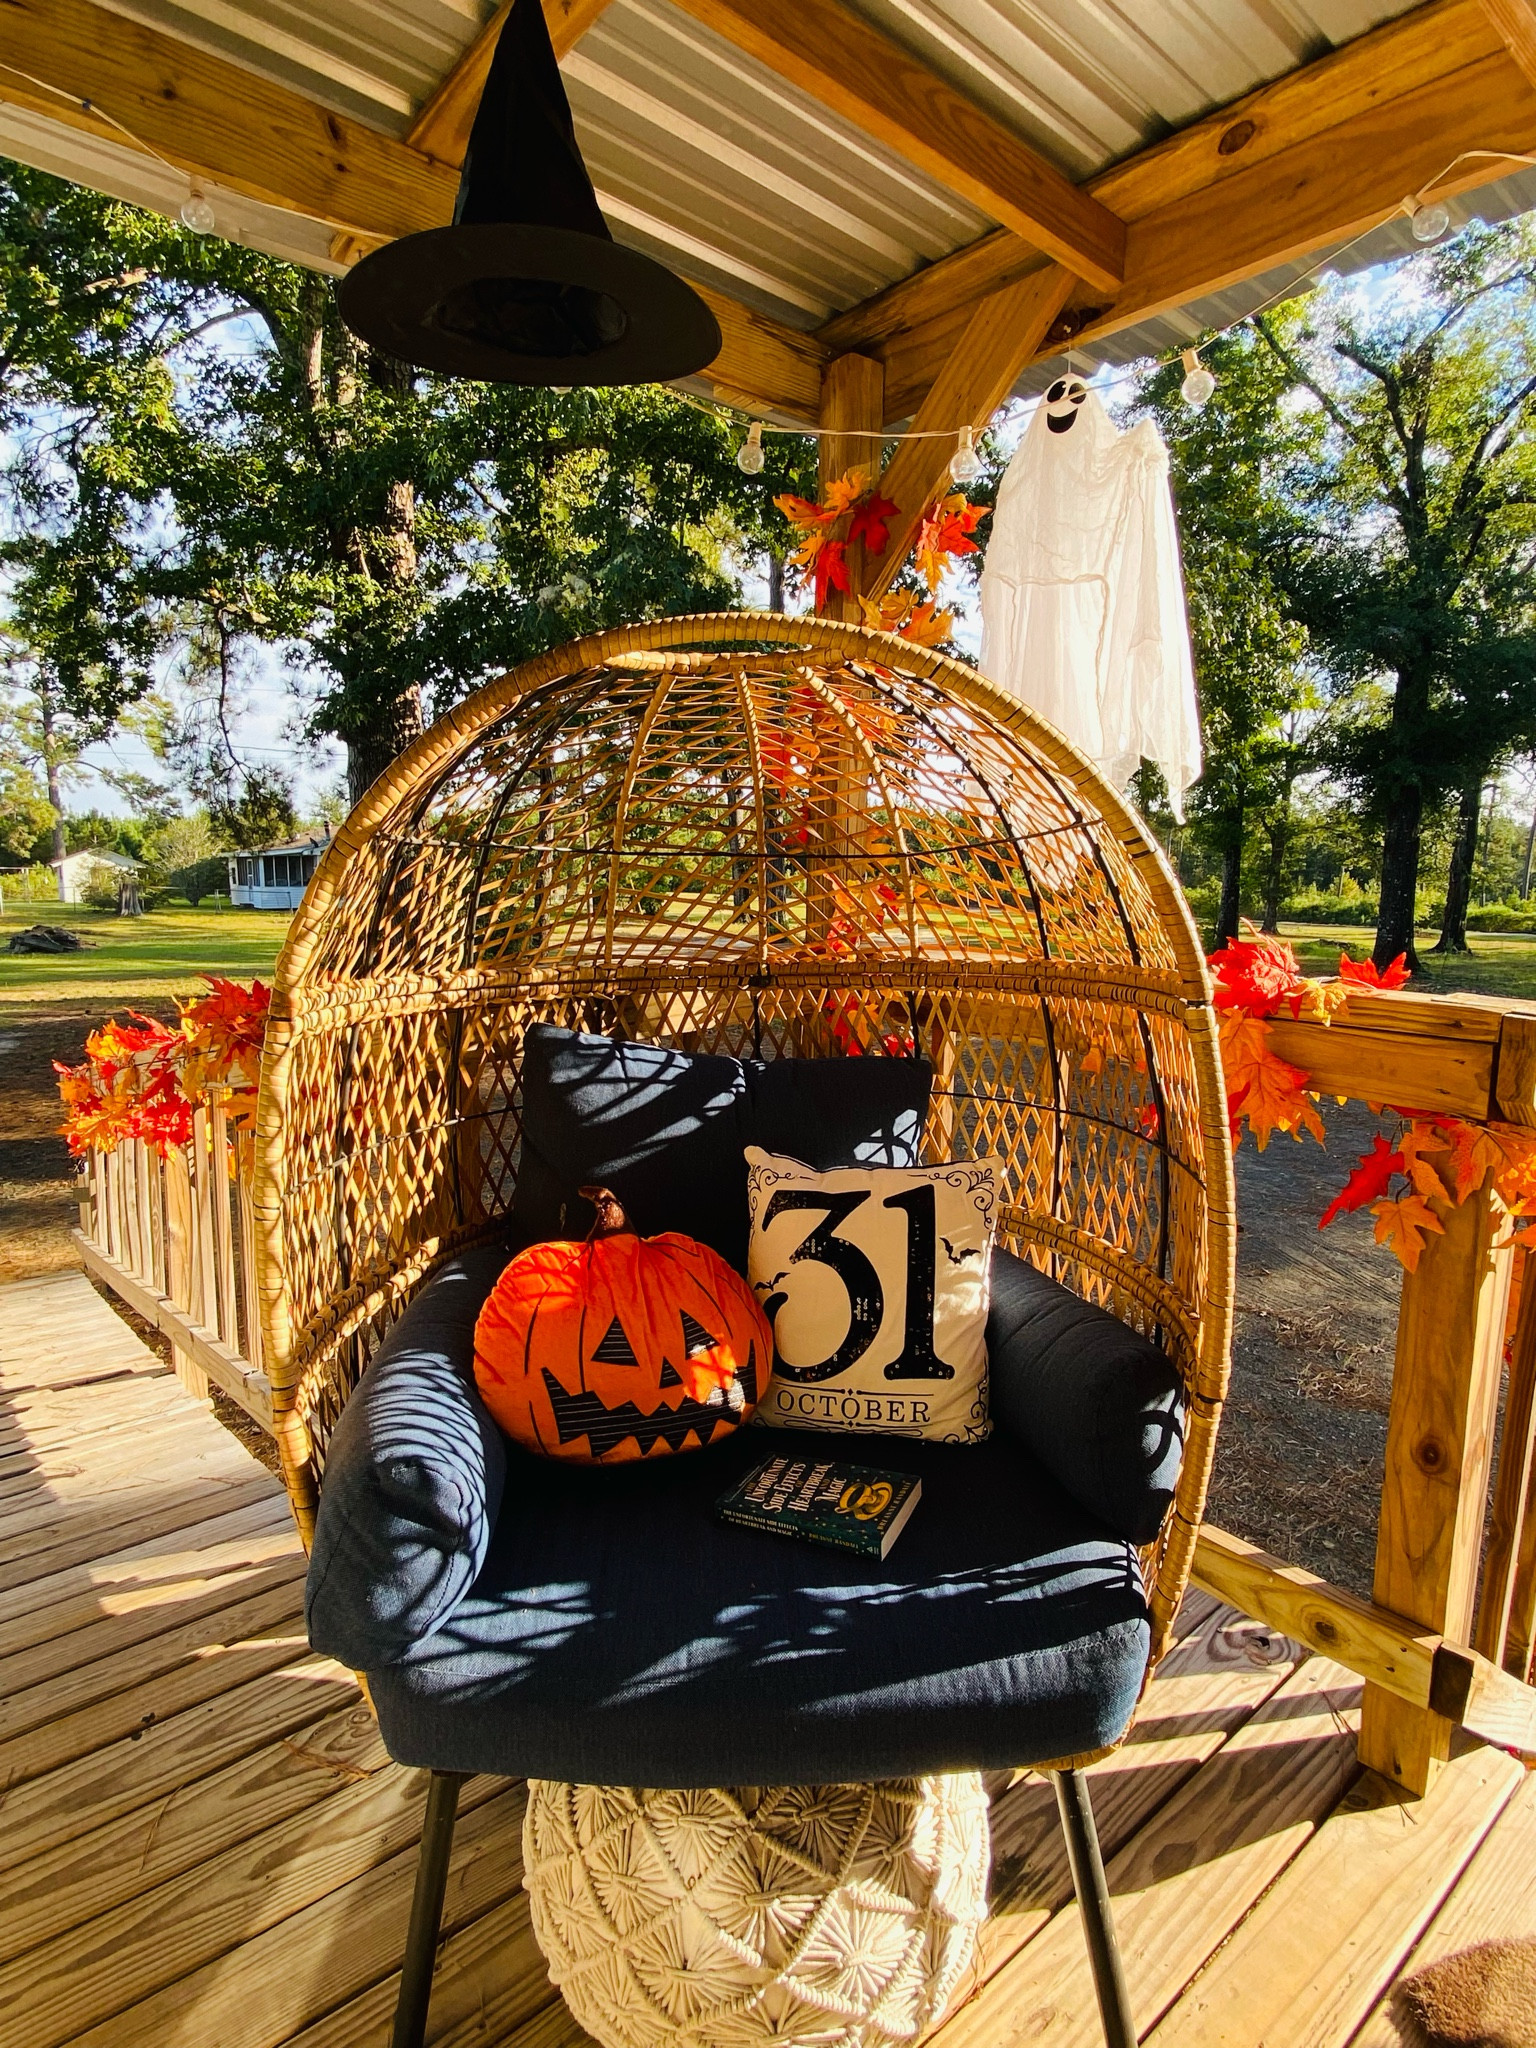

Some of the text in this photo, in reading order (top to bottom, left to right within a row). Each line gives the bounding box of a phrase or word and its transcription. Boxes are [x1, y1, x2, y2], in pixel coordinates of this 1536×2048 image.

[761, 1184, 955, 1383] 31
[777, 1390, 931, 1423] OCTOBER
[744, 1457, 790, 1503] UNFORTUNATE
[762, 1462, 807, 1514] SIDE EFFECTS
[787, 1461, 835, 1512] HEARTBREAK
[814, 1477, 847, 1503] MAGIC
[777, 1521, 799, 1531] EFFECTS
